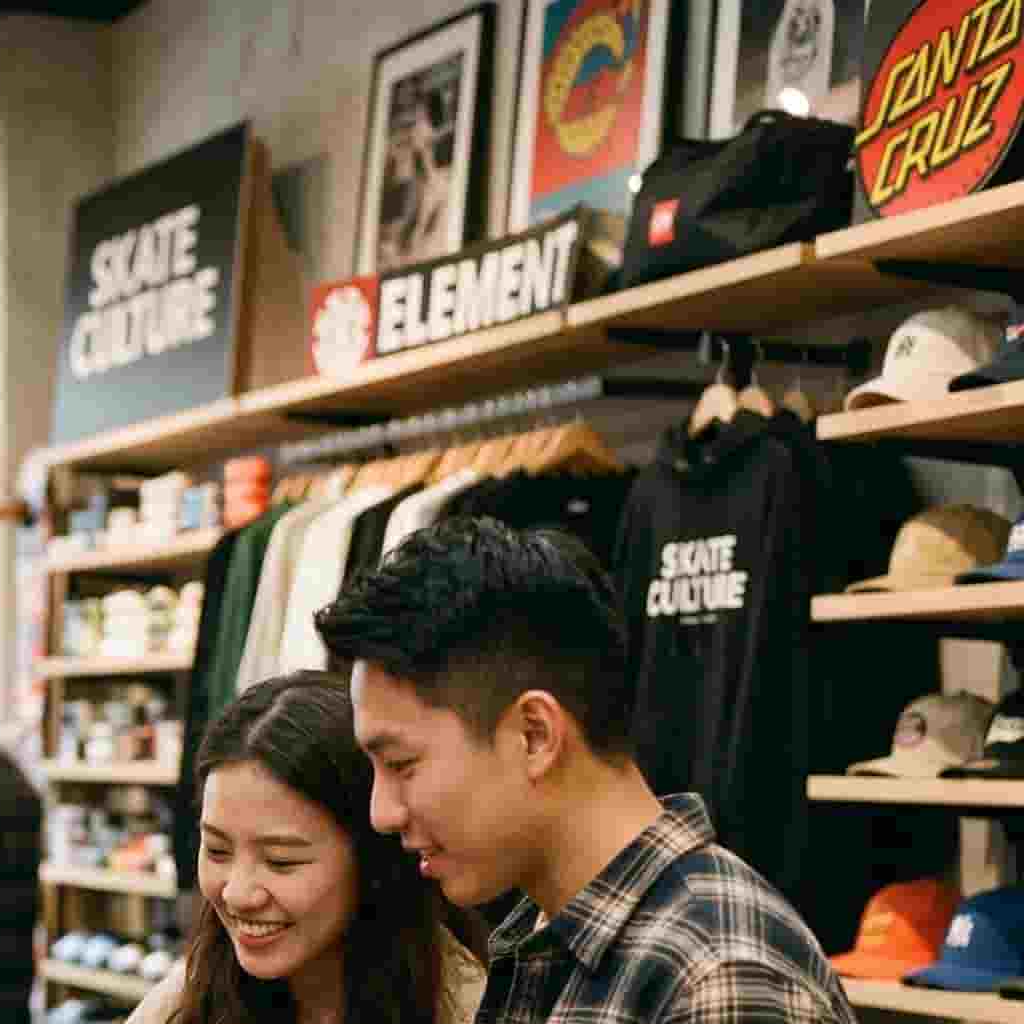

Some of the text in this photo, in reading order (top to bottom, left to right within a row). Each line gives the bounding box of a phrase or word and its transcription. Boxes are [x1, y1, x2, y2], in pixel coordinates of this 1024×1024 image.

[855, 0, 1022, 146] SANTA
[871, 60, 1013, 207] CRUZ
[90, 204, 200, 306] SKATE
[377, 220, 579, 354] ELEMENT
[69, 266, 219, 380] CULTURE
[646, 570, 748, 617] CULTURE
[660, 534, 737, 578] SKATE
